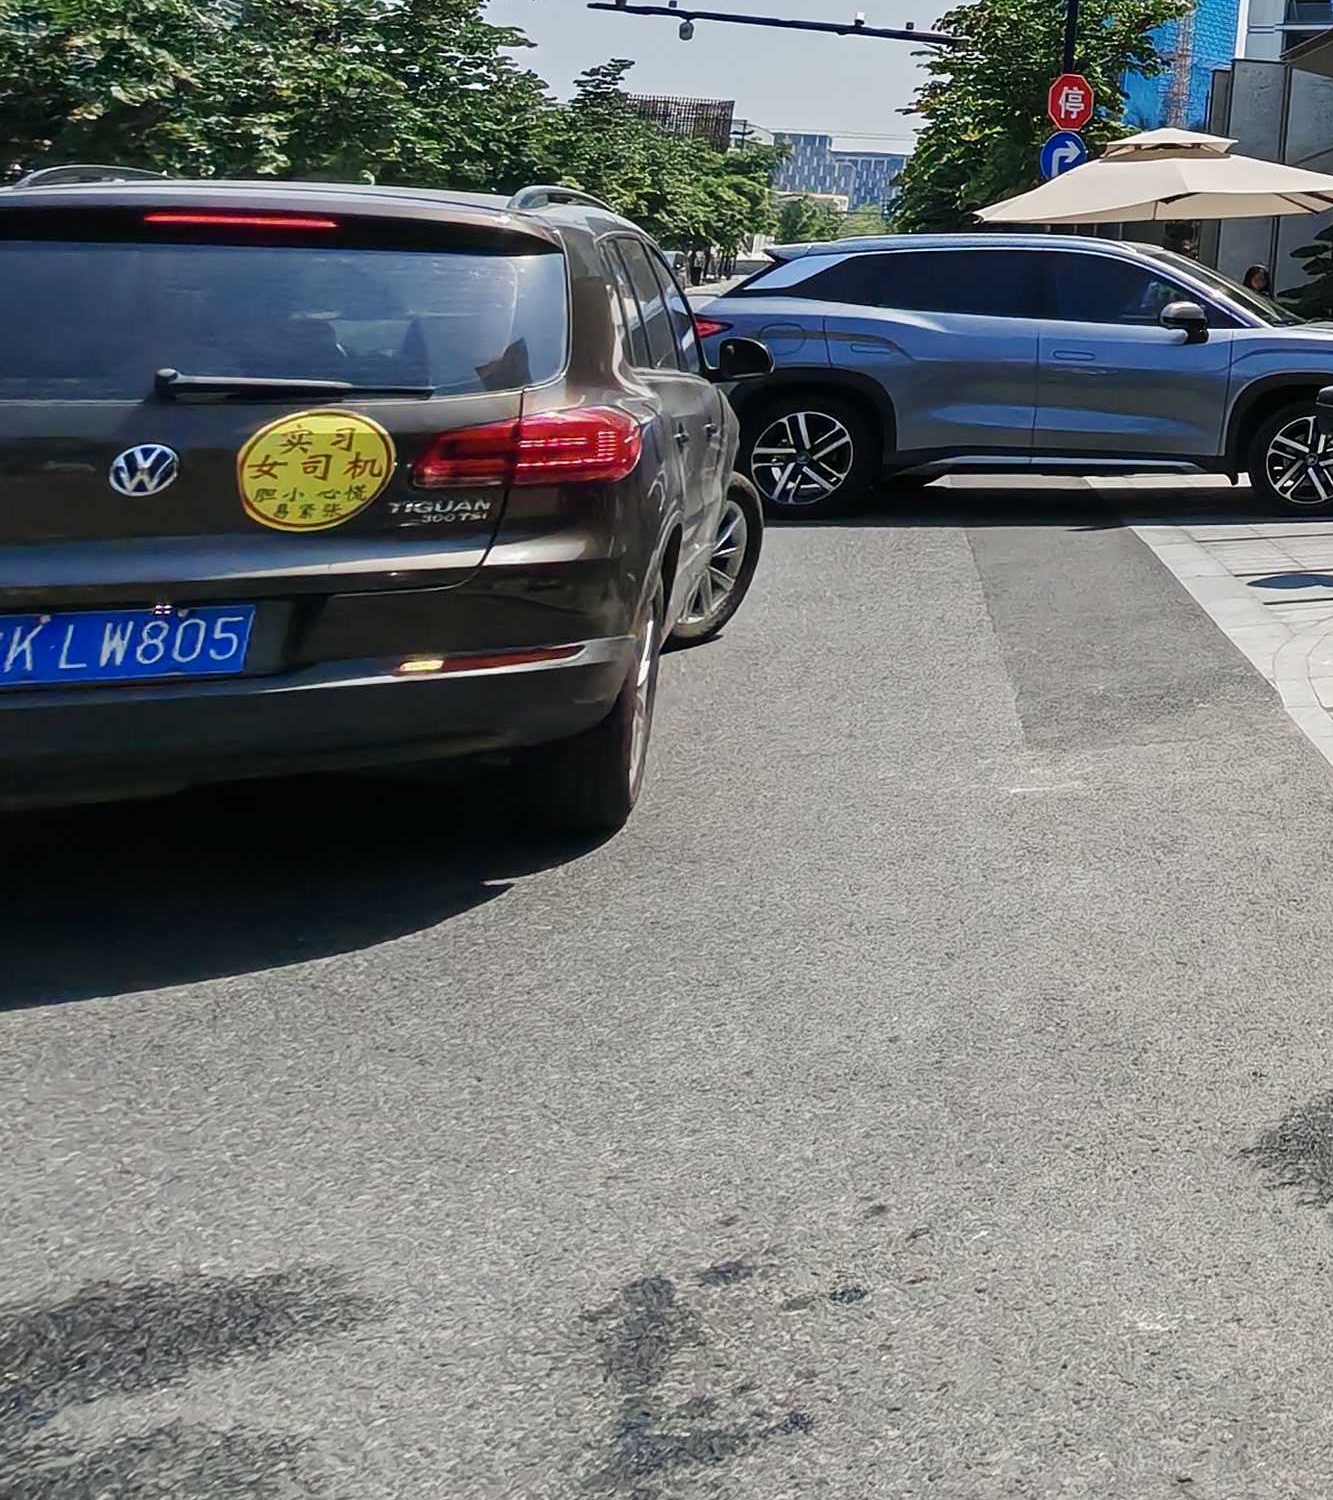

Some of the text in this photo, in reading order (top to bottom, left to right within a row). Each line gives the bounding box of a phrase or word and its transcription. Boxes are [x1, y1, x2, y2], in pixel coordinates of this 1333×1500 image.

[1058, 86, 1085, 119] 停
[279, 425, 356, 454] 实习
[247, 452, 383, 481] 女司机
[388, 499, 491, 514] TIGUAN
